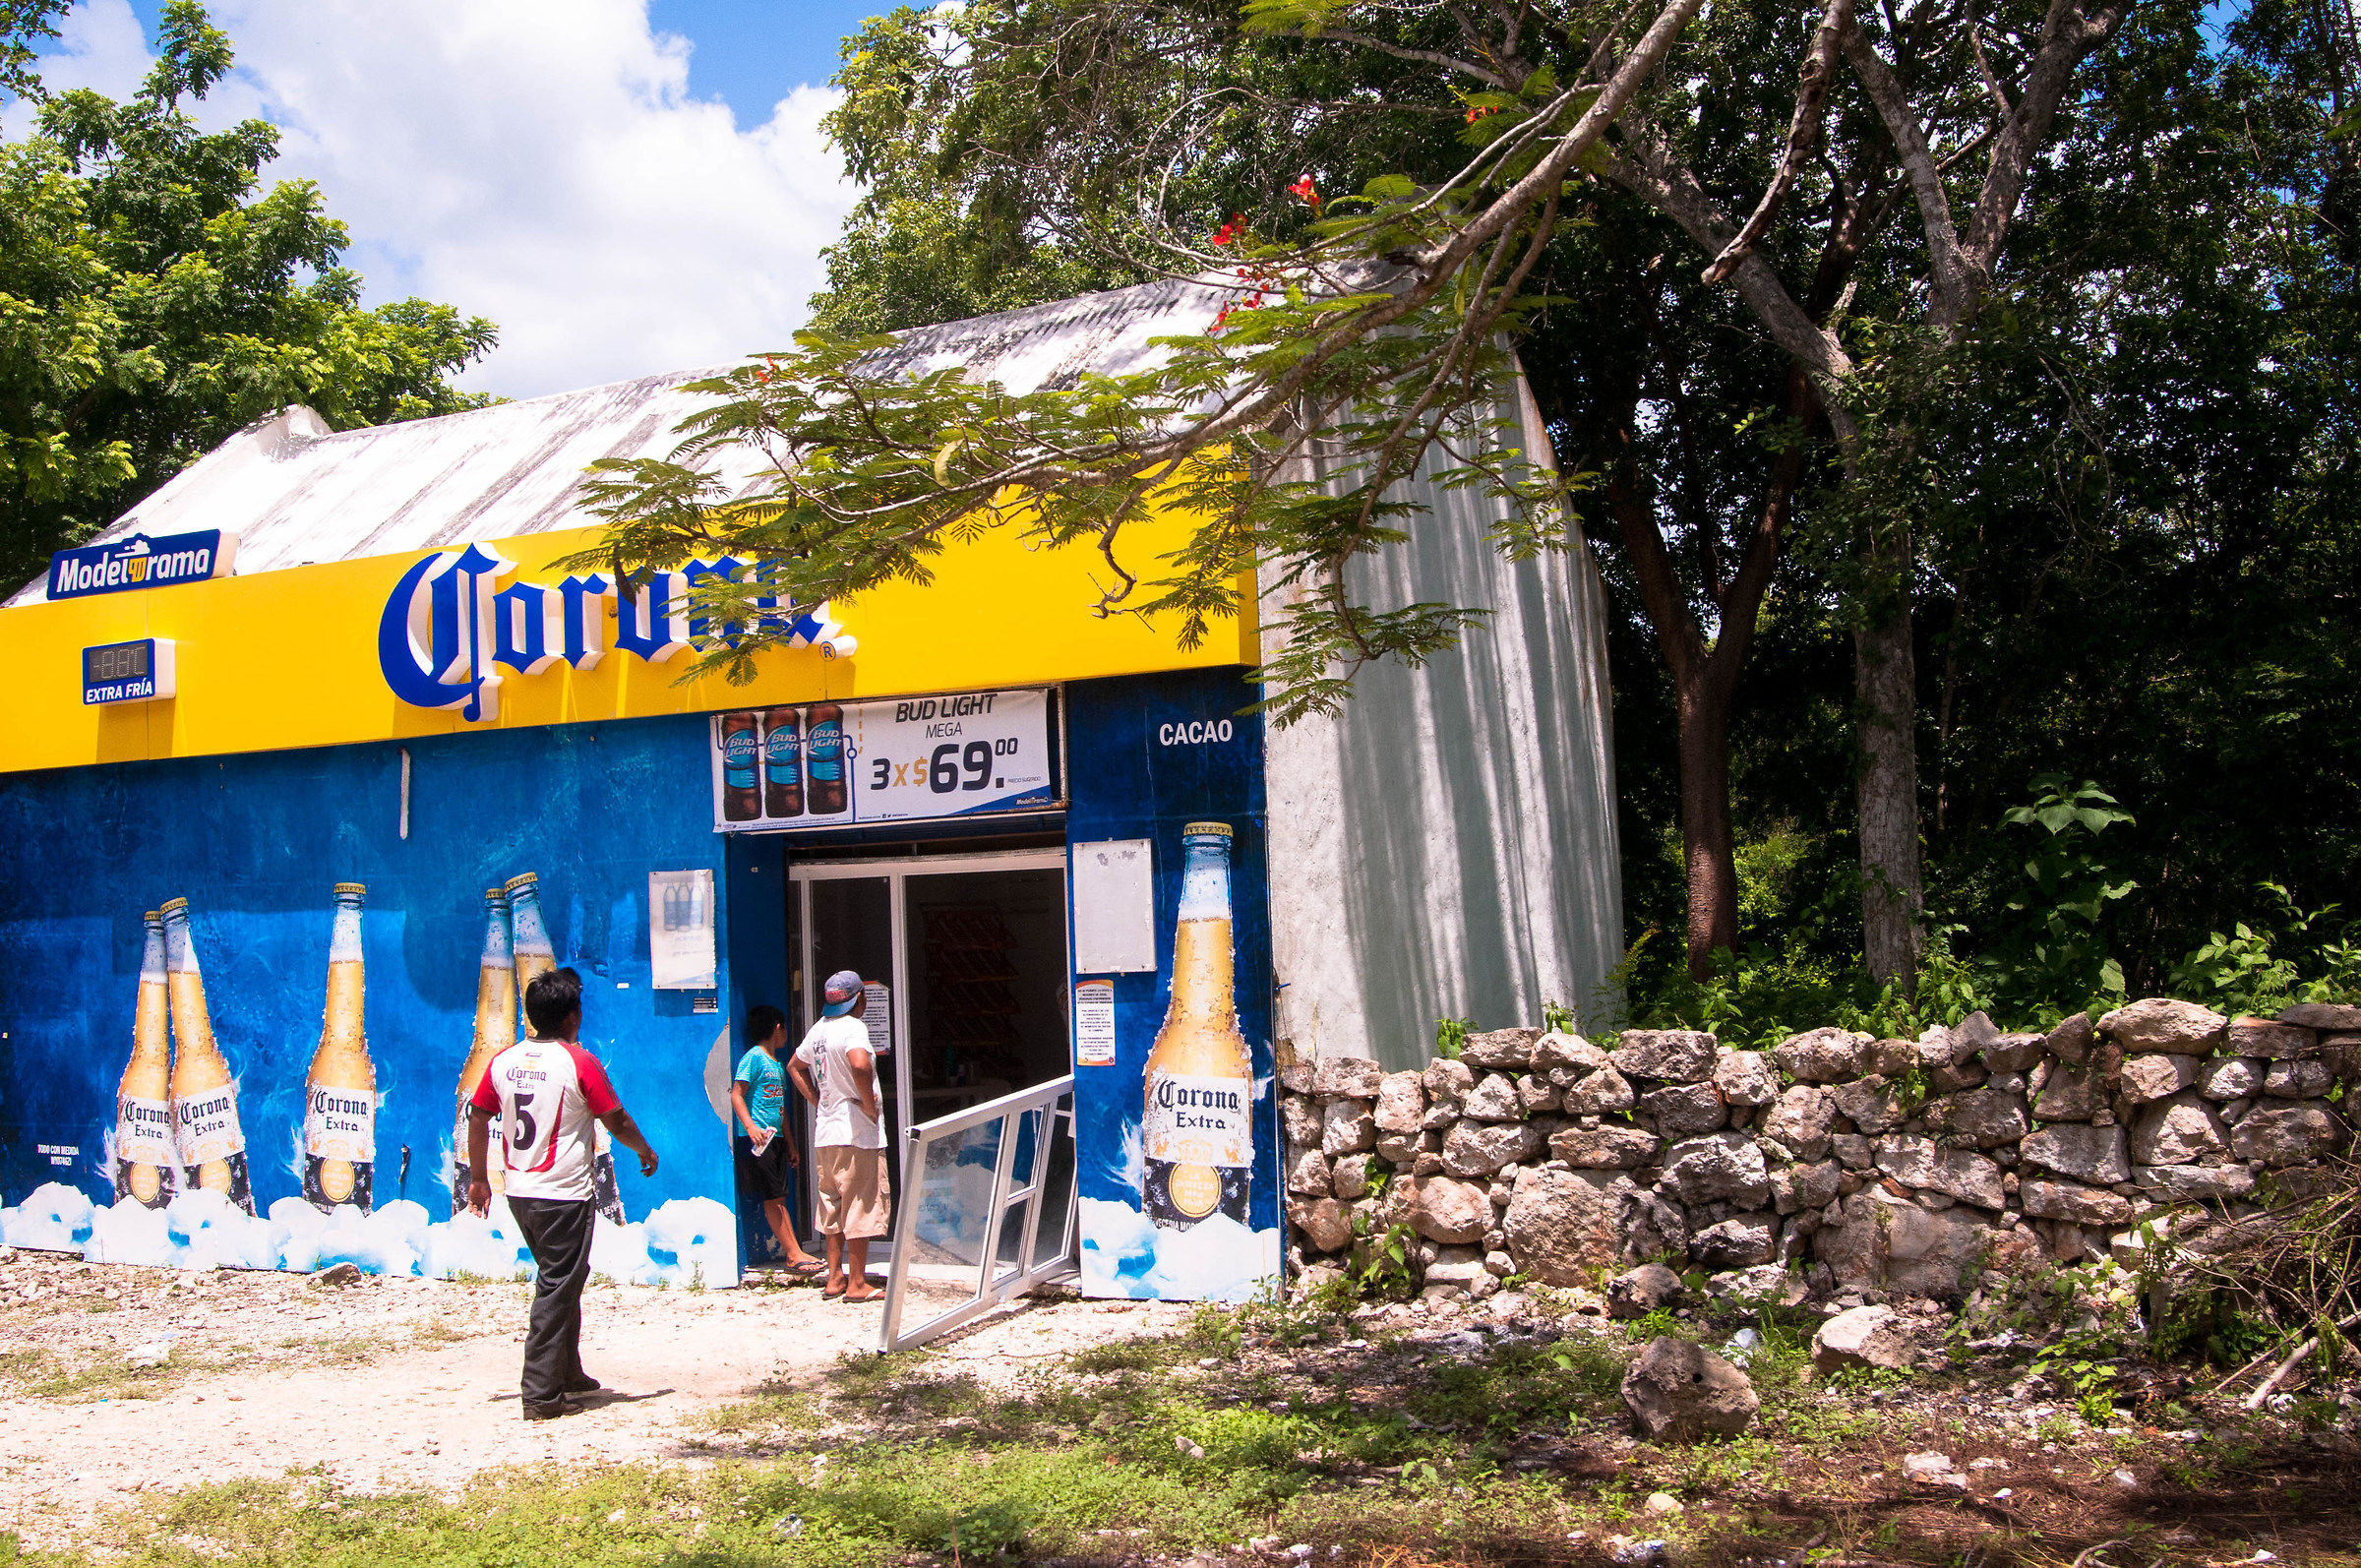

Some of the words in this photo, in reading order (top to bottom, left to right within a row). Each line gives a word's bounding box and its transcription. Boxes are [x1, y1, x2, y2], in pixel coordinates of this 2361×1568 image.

[86, 686, 123, 702] EXTRA
[125, 677, 153, 697] FRÍA
[895, 700, 936, 723] BUD
[940, 694, 998, 718] LIGHT
[771, 734, 797, 743] BUD
[814, 729, 839, 739] BUD
[926, 722, 962, 739] MEGA
[1159, 719, 1233, 747] CACAO
[730, 738, 755, 747] BUD
[871, 758, 890, 790] 3
[506, 1066, 547, 1081] Corona
[315, 1090, 367, 1116] Corona
[1157, 1079, 1240, 1112] Corona
[125, 1101, 170, 1124] Corona
[180, 1097, 229, 1126] Corona
[195, 1120, 225, 1136] Extra
[326, 1116, 359, 1131] Extra
[513, 1093, 536, 1151] 5
[1176, 1112, 1227, 1129] Extra
[135, 1124, 163, 1139] Extra
[50, 1145, 61, 1155] CON
